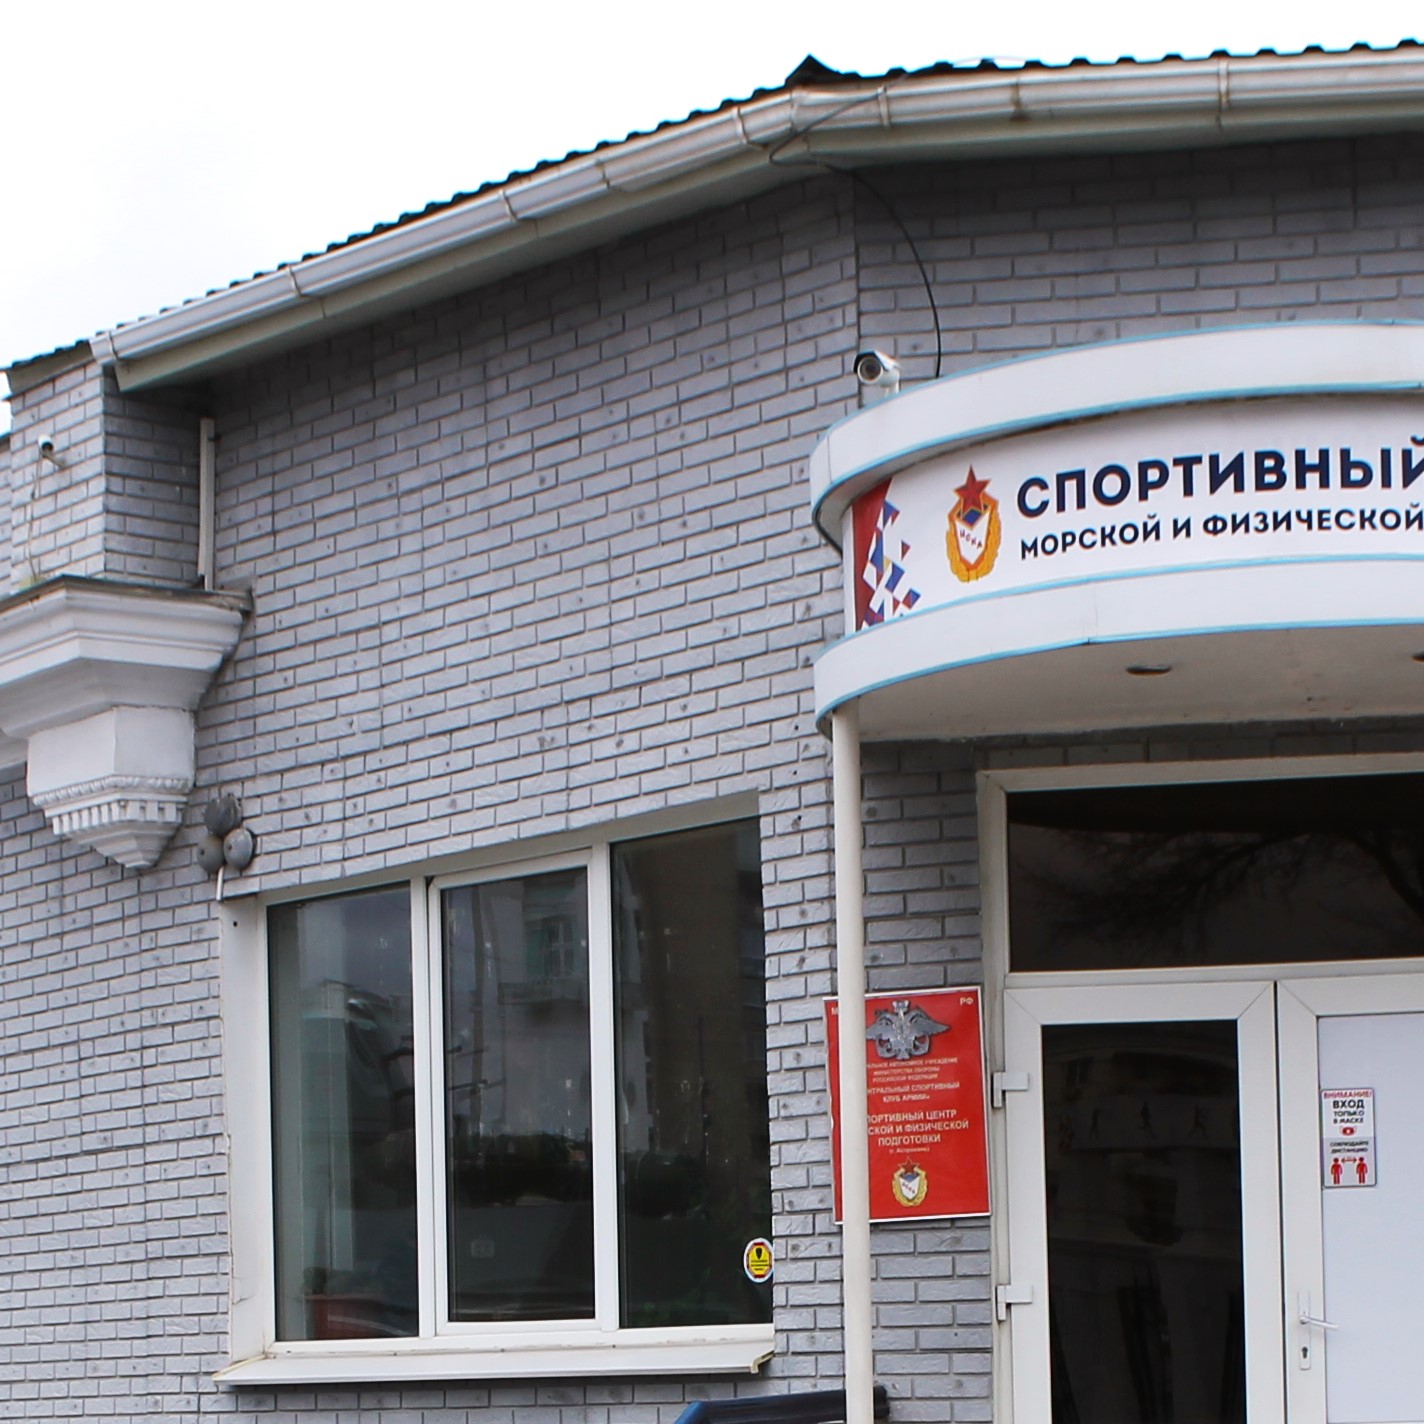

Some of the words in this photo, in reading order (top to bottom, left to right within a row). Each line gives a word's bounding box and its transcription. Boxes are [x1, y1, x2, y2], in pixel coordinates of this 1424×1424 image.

[1020, 512, 1161, 561] МОРСКОЙ
[1172, 515, 1192, 540] И
[1202, 503, 1424, 537] ФИЗИЧЕСКОЙ
[1333, 1099, 1365, 1109] ВХОД
[926, 1109, 957, 1121] ЦЕНТР
[896, 1125, 903, 1133] И
[904, 1118, 969, 1132] ФИЗИЧЕСКОЙ
[878, 1133, 941, 1146] ПОДГОТОВКИ
